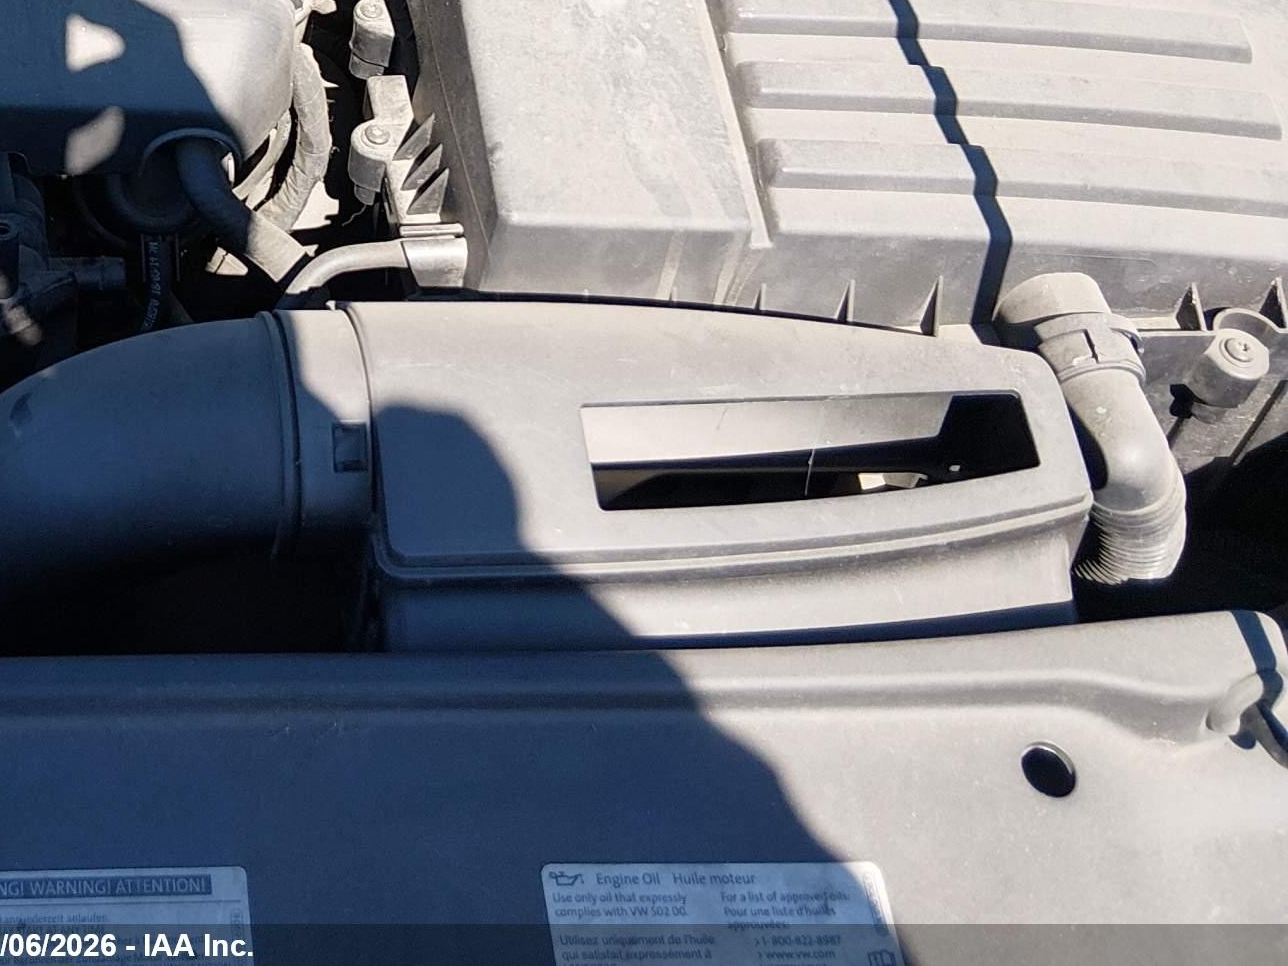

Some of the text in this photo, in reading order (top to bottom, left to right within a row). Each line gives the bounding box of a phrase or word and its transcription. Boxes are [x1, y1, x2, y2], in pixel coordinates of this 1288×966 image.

[596, 872, 755, 889] Engine Oil Huile moteur
[30, 880, 111, 897] WARNING!
[115, 878, 206, 895] ATTENTION!
[552, 892, 687, 905] Use only oil that expressly
[720, 892, 737, 902] For
[748, 891, 764, 902] list
[767, 891, 778, 902] of
[555, 906, 601, 919] complies
[605, 906, 630, 916] with
[631, 906, 648, 916] VW
[652, 906, 669, 916] 502
[724, 906, 747, 916] Pour
[750, 908, 769, 916] une
[772, 905, 793, 916] liste
